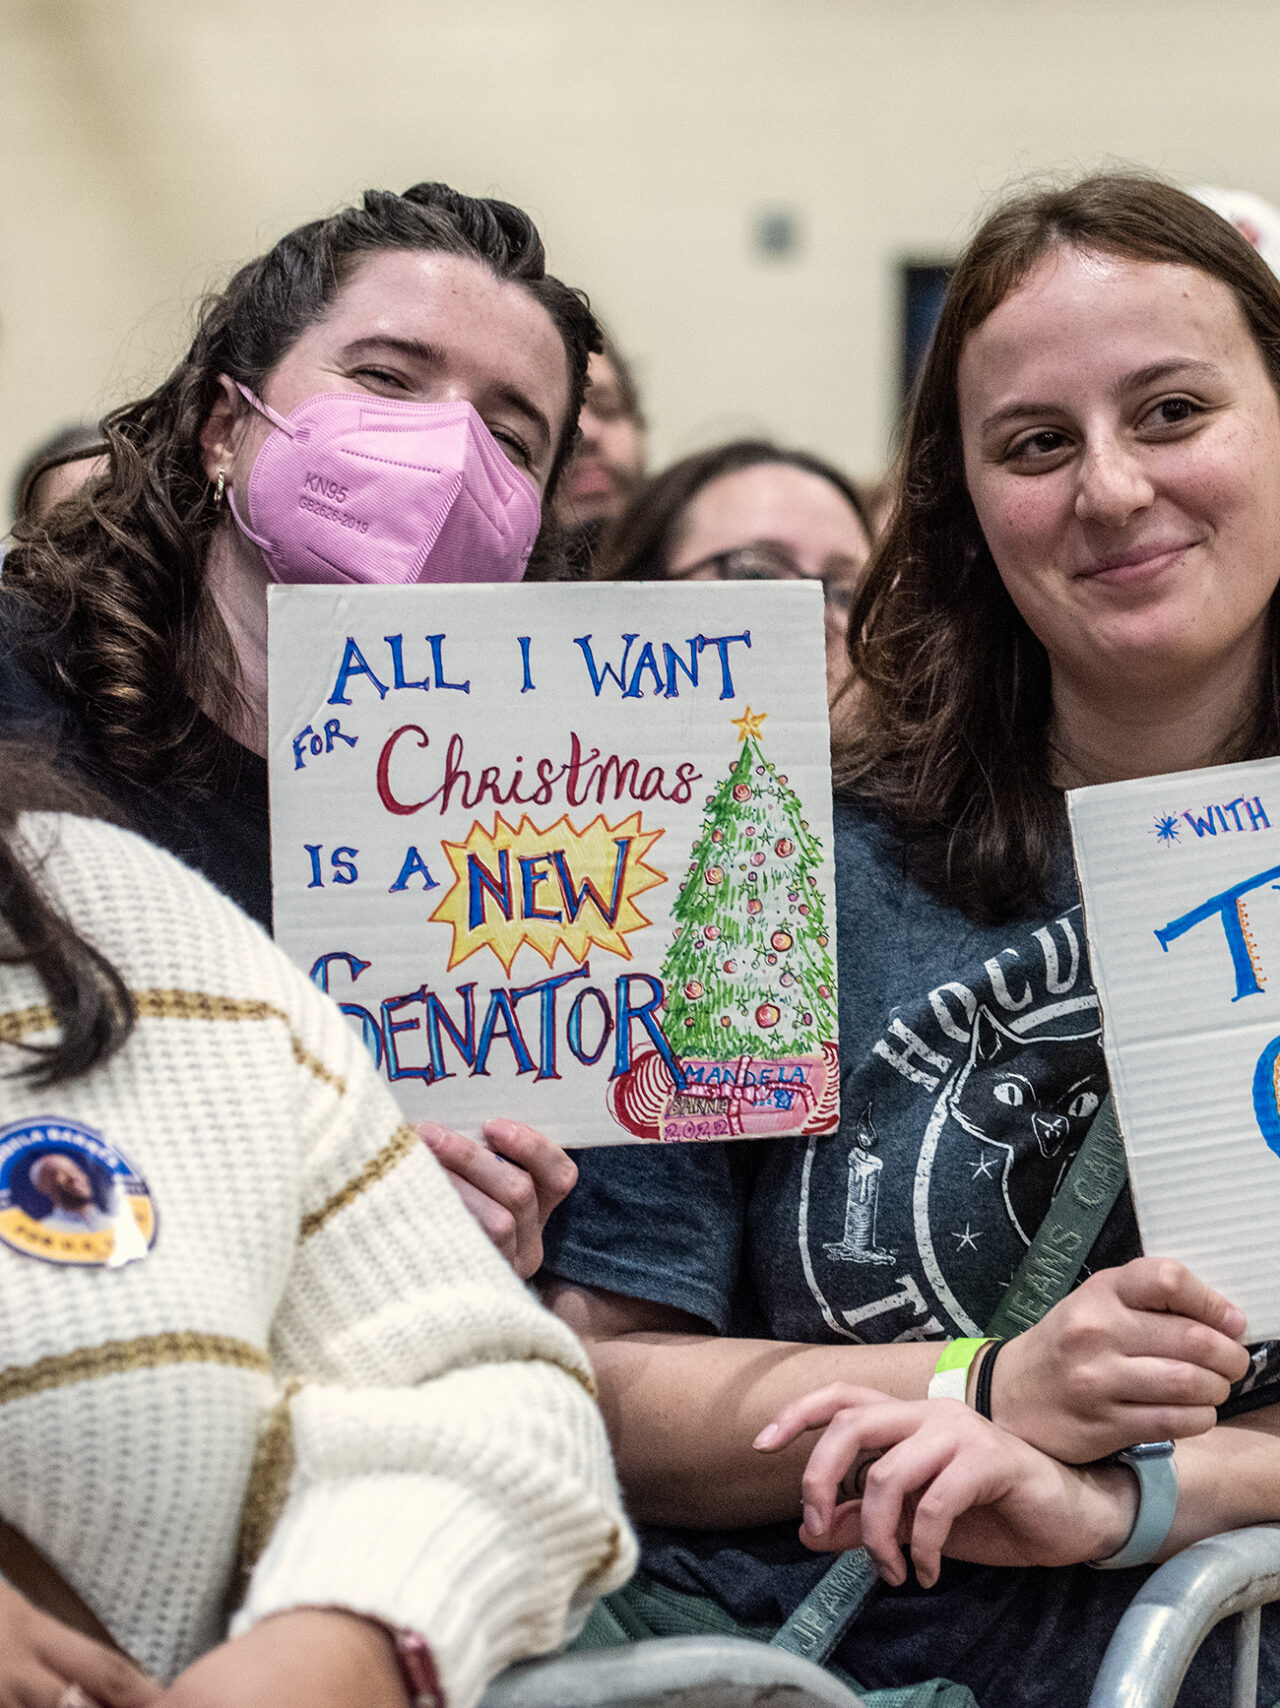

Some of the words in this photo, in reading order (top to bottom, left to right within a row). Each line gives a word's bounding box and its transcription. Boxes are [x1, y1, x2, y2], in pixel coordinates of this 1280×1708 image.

[299, 496, 369, 534] GB2626-2019
[304, 472, 349, 503] KN95
[328, 634, 470, 705] ALL
[517, 636, 534, 692] I
[573, 630, 752, 700] WANT
[293, 718, 358, 770] FOR
[376, 724, 703, 816] Christmas
[304, 844, 359, 889] IS
[389, 846, 440, 893] A
[467, 838, 631, 931] NEW
[309, 951, 690, 1090] SENATOR
[871, 917, 1080, 1094] HOCU
[686, 1063, 806, 1084] MANDELA
[663, 1118, 729, 1142] 2022
